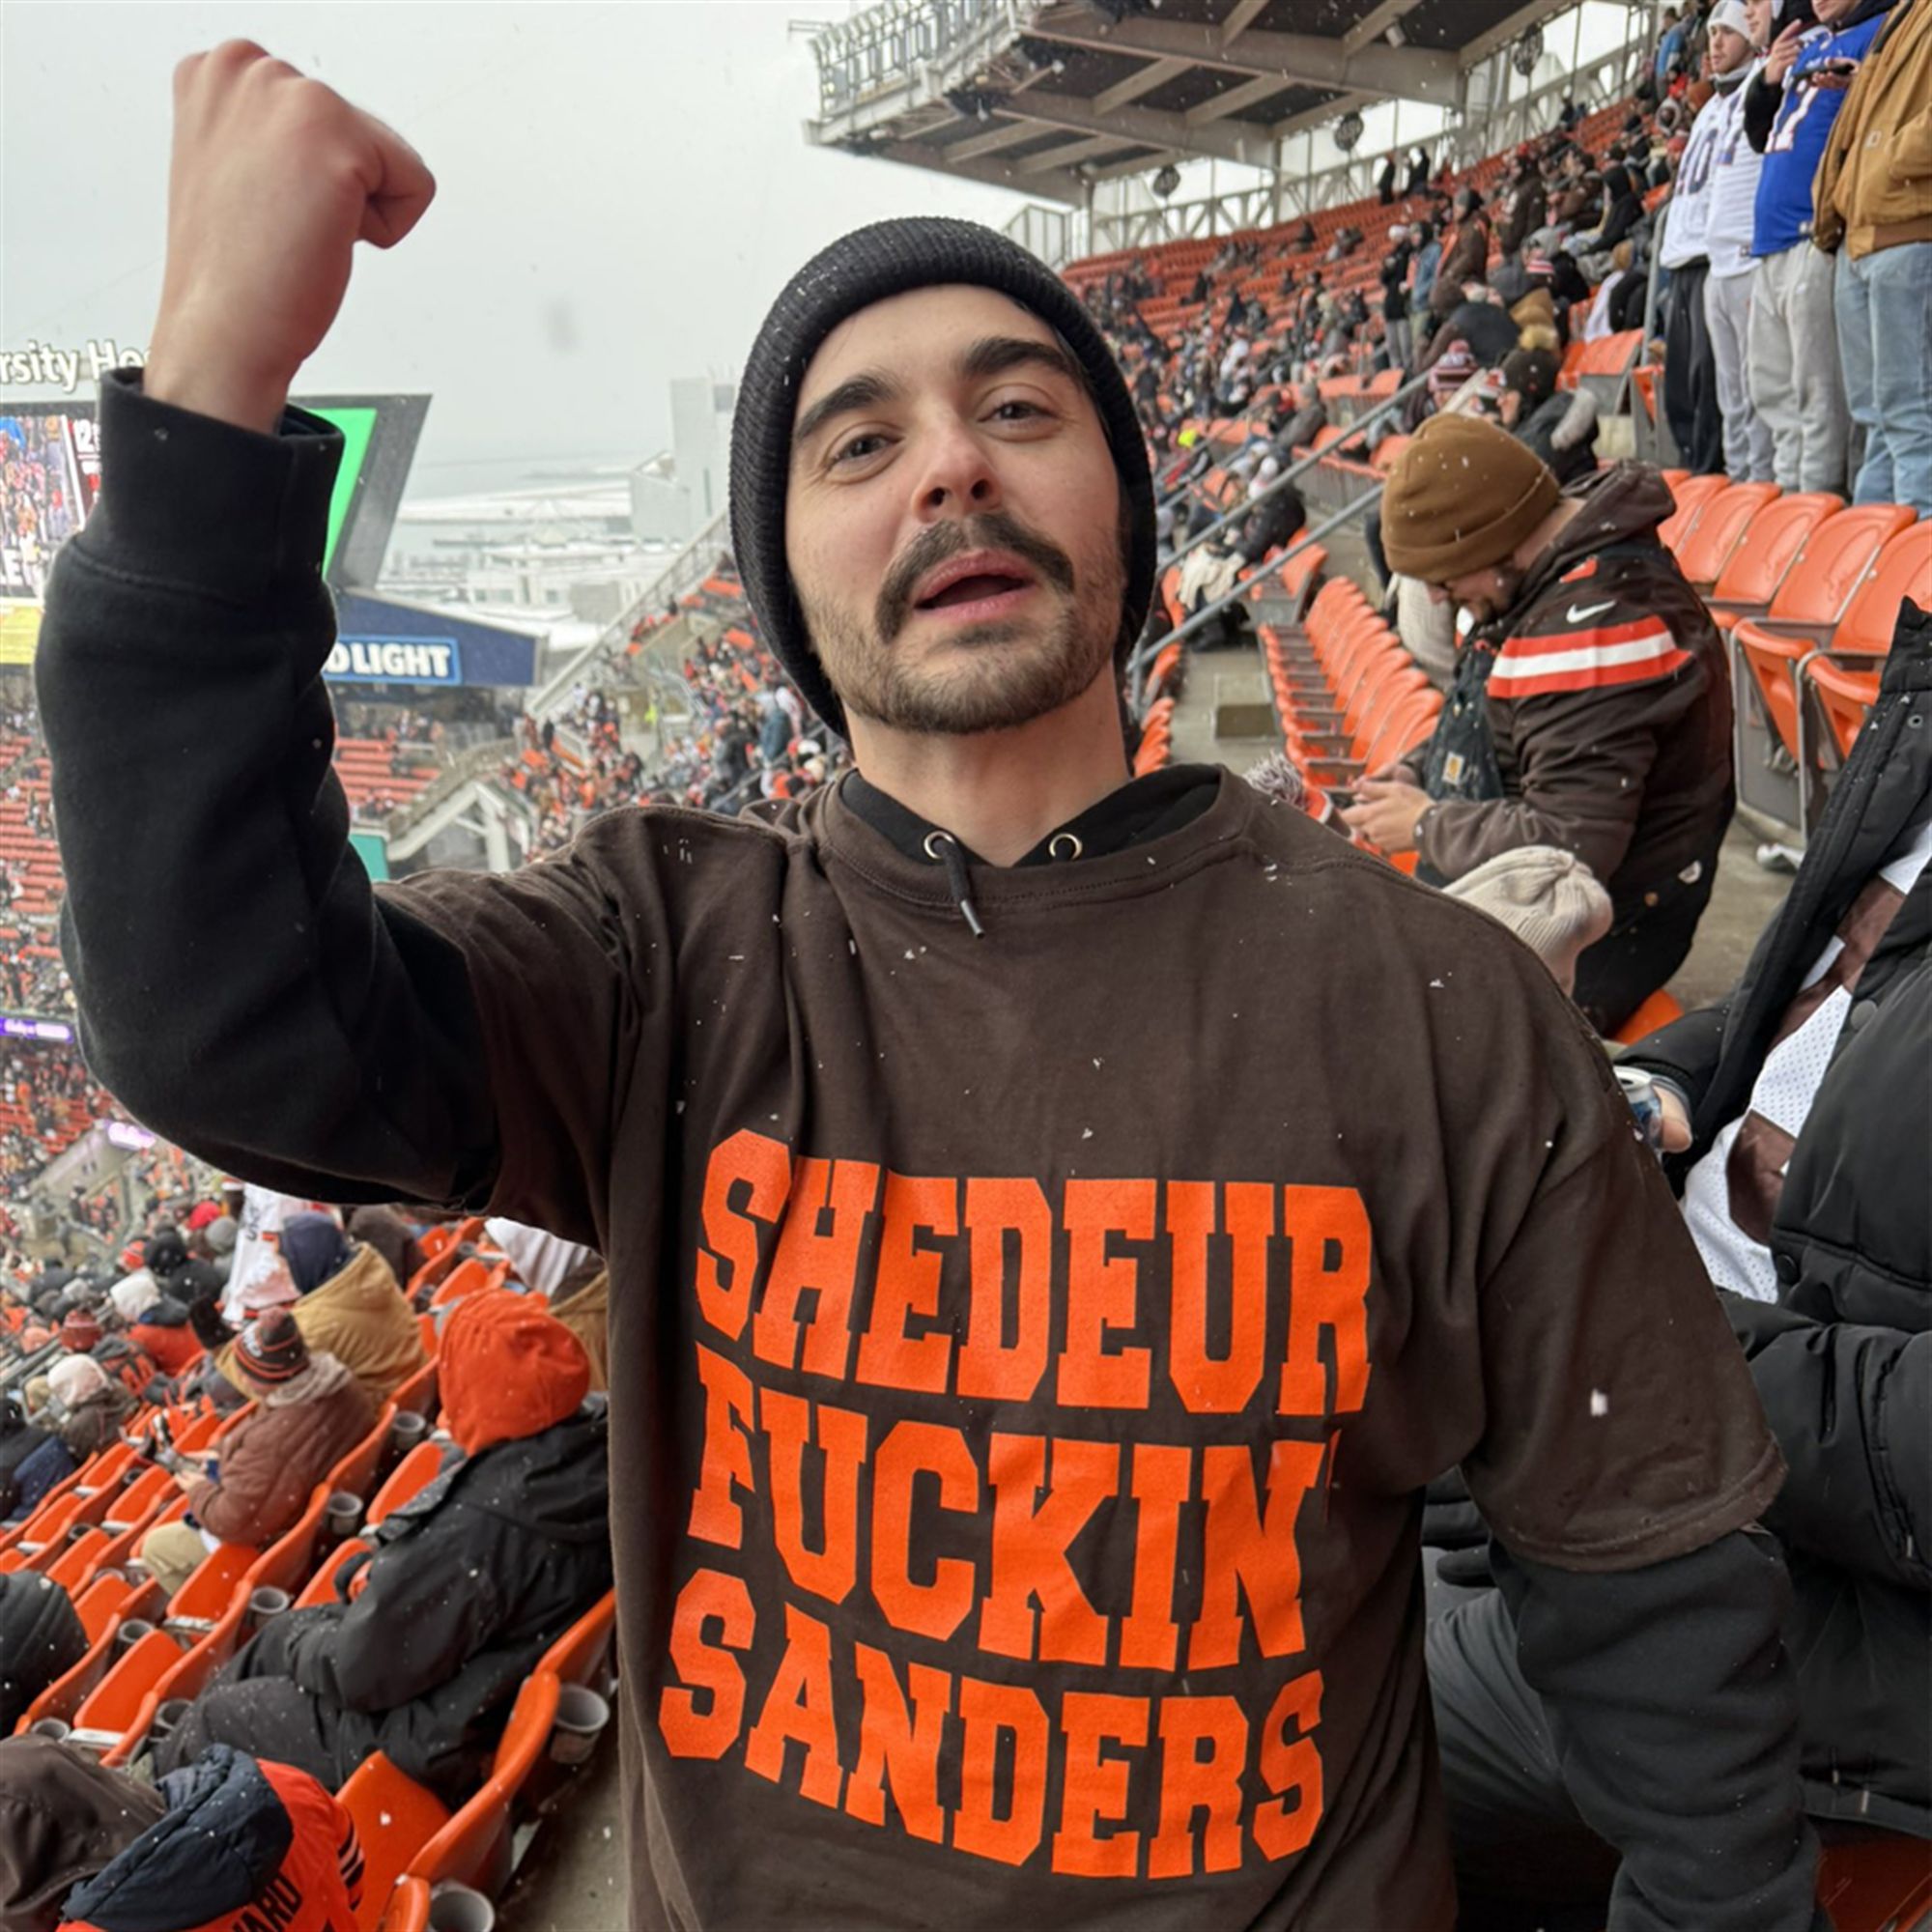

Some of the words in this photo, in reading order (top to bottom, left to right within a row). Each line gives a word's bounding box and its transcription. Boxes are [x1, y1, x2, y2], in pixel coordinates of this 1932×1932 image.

[0, 339, 79, 394] rsity
[87, 339, 151, 382] Ho
[695, 1128, 1373, 1416] SHEDEUR
[659, 1568, 1324, 1879] SANDERS
[232, 1872, 303, 1932] ARD
